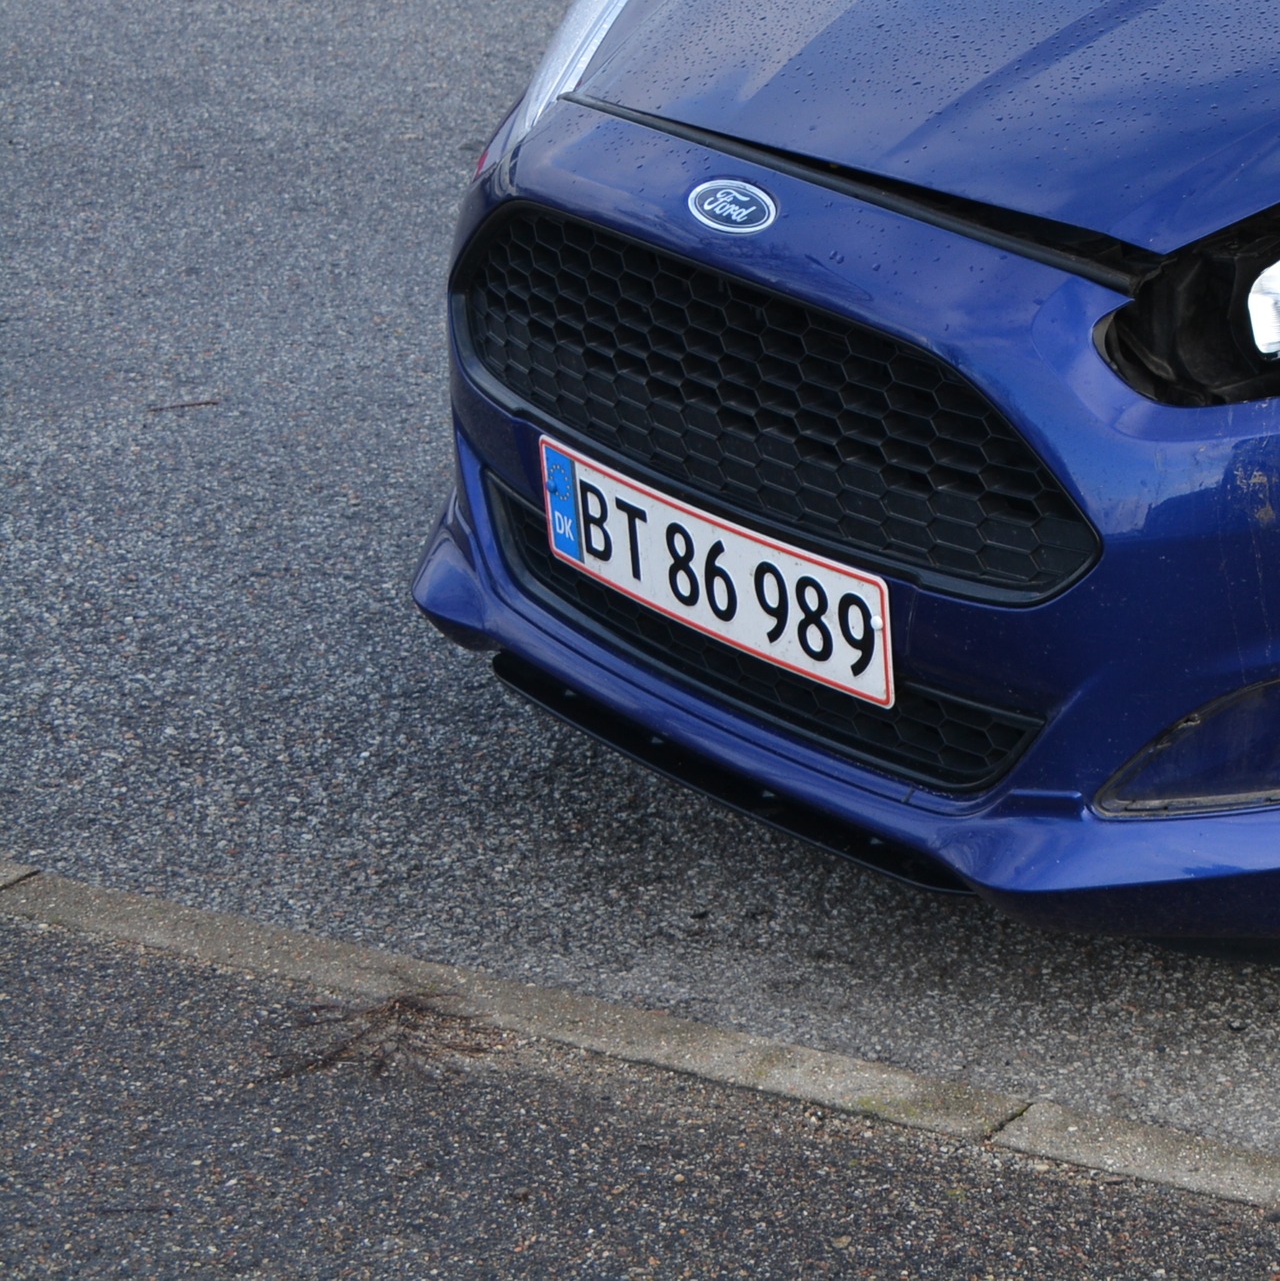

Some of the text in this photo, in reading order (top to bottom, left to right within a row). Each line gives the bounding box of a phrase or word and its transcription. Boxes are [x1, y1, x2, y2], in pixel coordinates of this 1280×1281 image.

[703, 188, 757, 223] Ford
[554, 510, 576, 542] DK
[579, 477, 876, 678] BT 86 989
